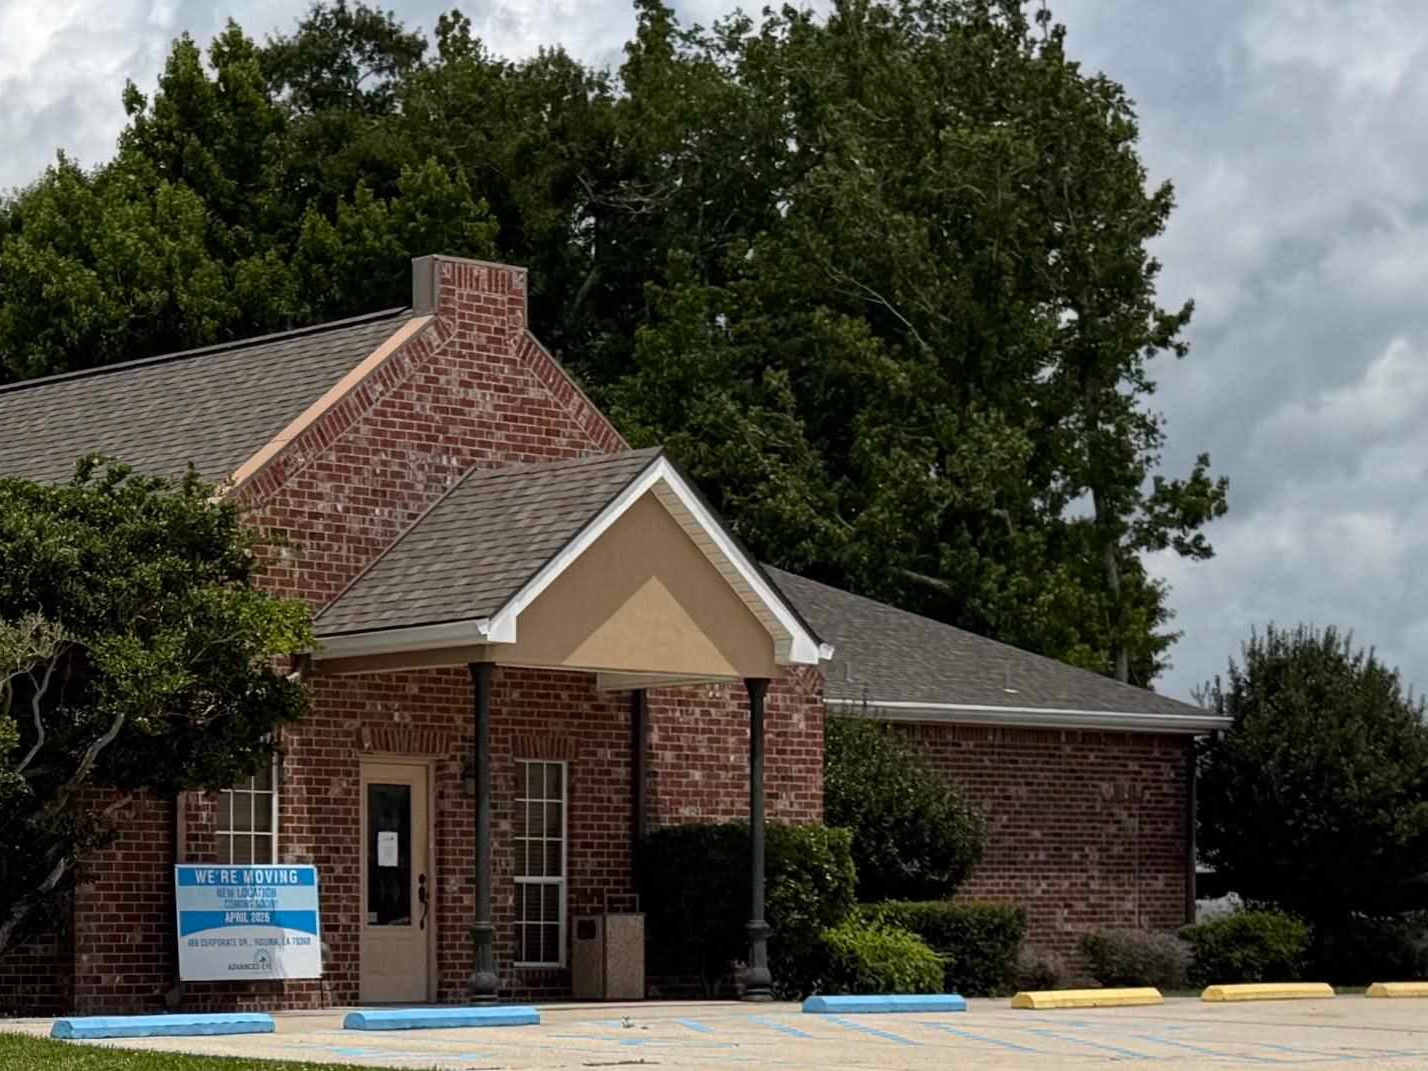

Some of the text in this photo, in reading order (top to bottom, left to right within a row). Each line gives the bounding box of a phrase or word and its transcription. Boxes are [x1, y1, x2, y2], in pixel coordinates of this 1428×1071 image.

[195, 869, 299, 884] WE'RE MOVING
[225, 912, 249, 923] APRIL
